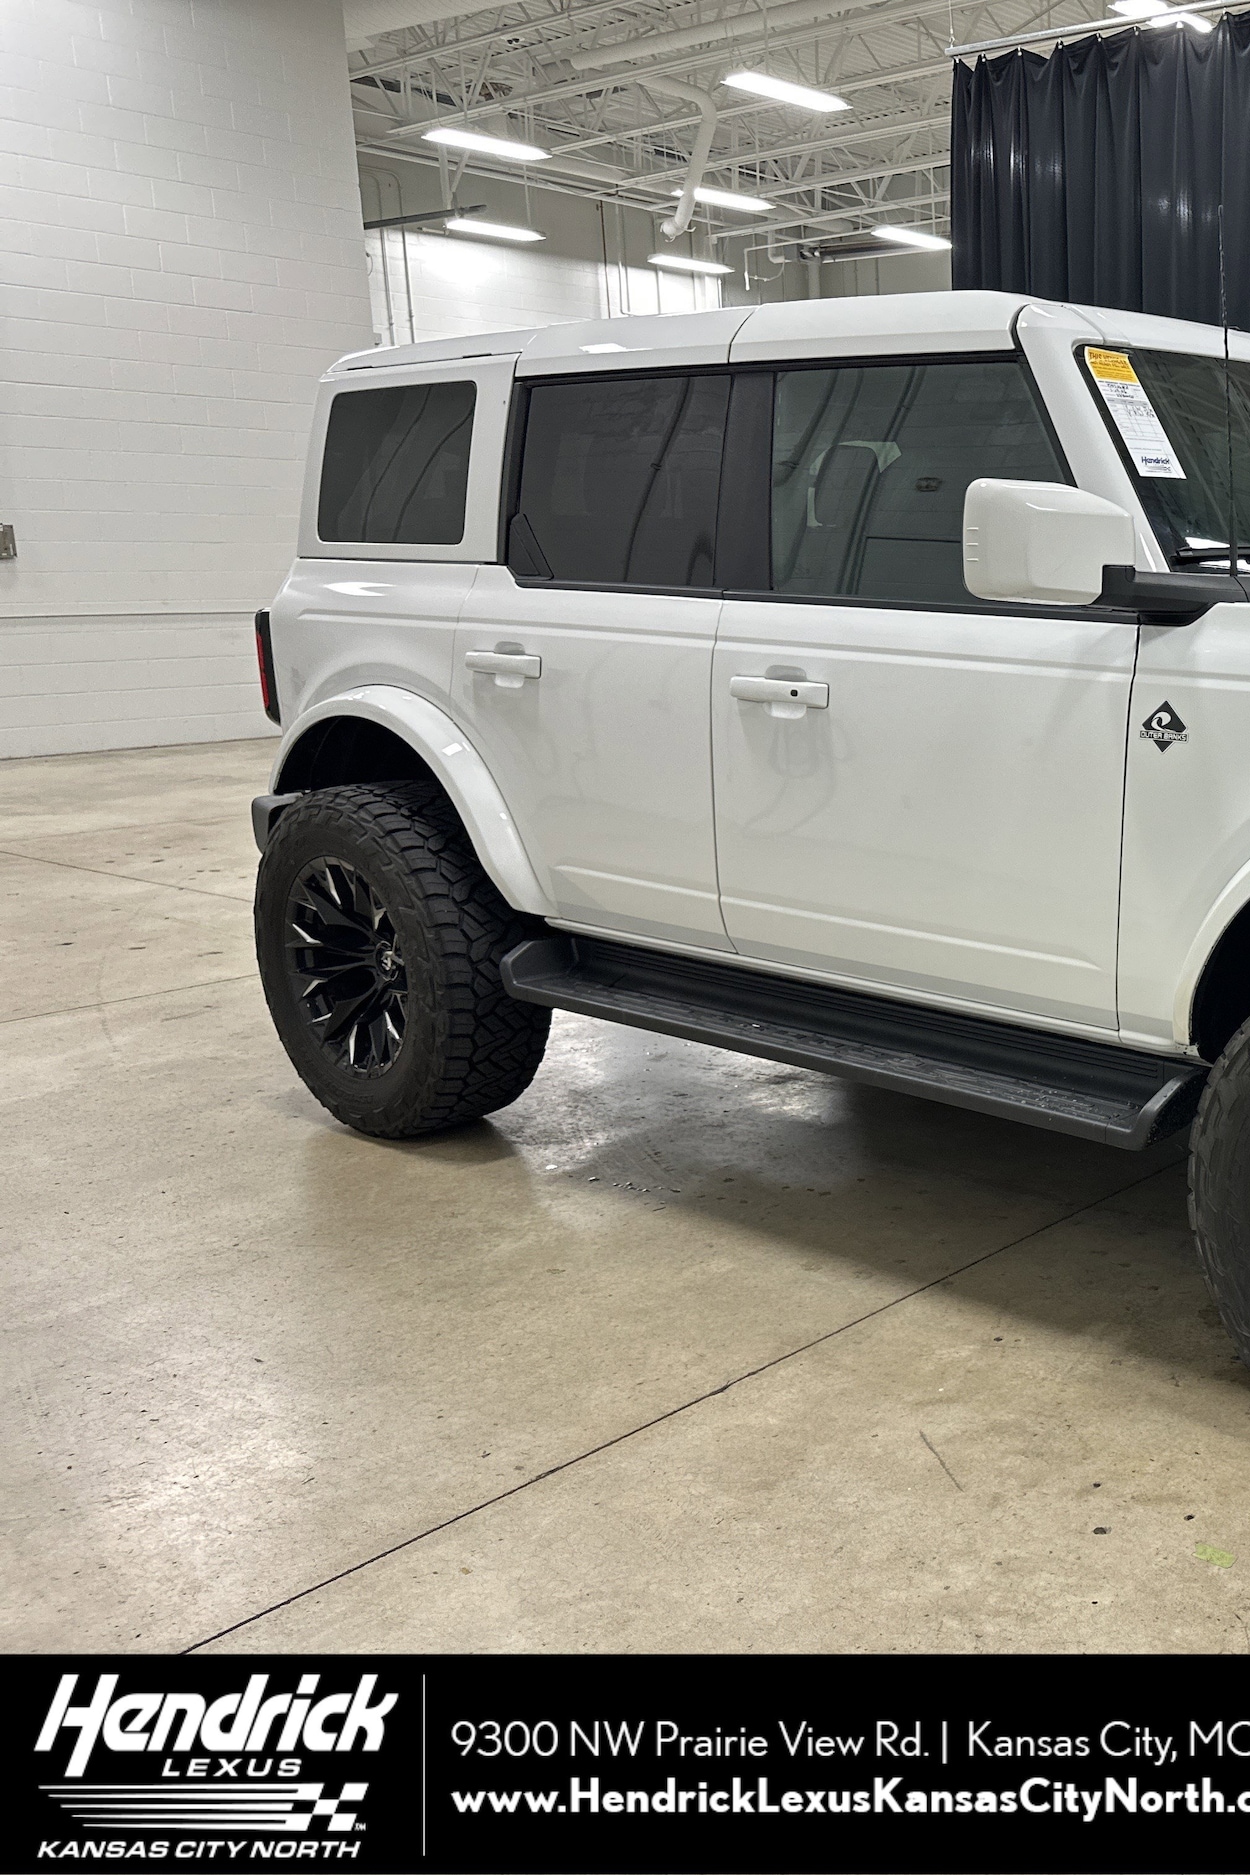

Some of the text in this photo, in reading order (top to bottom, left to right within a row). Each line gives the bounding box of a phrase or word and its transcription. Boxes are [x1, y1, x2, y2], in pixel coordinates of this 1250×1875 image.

[1141, 456, 1170, 465] Hendrick
[1140, 731, 1187, 742] OUTER BANKS
